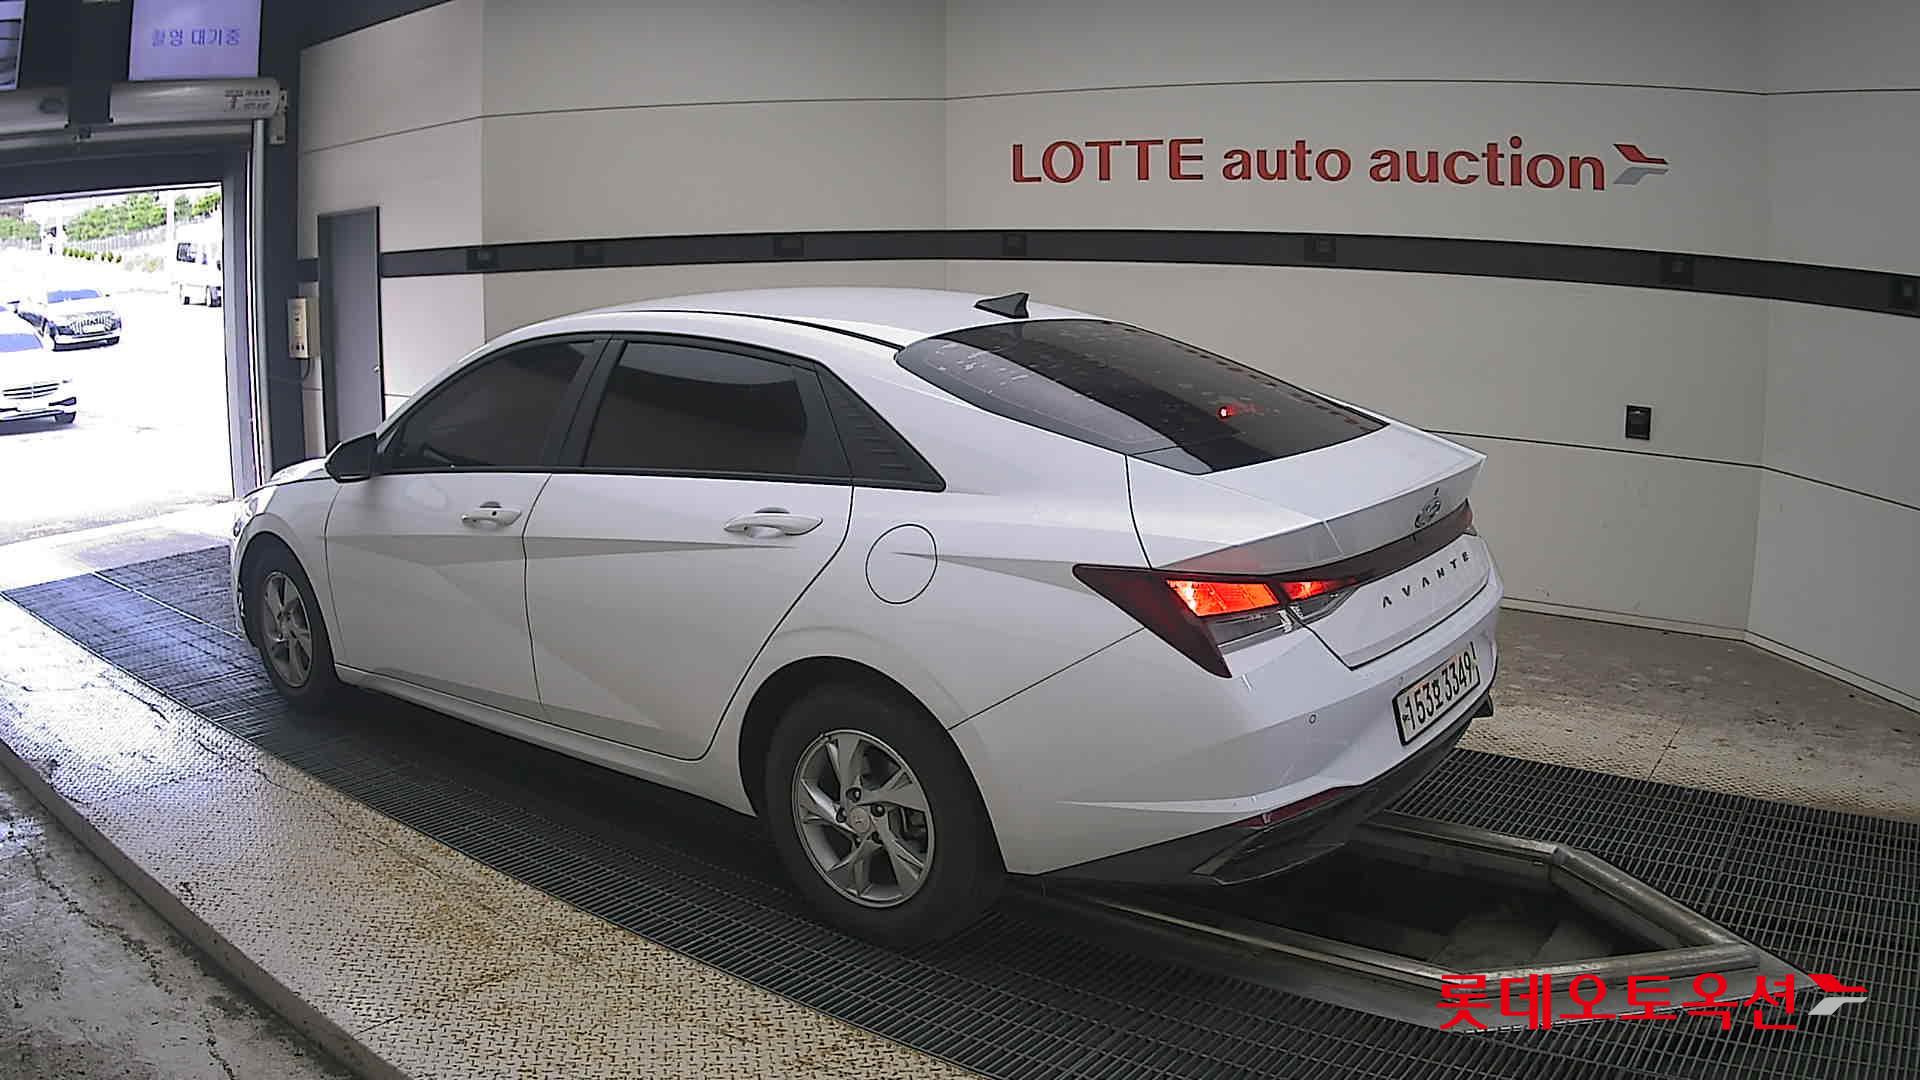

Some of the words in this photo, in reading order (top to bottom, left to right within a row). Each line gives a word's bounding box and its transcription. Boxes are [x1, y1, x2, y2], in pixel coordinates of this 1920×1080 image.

[191, 27, 241, 46] 대기중
[1011, 137, 1205, 184] LOTTE
[1221, 139, 1353, 183] auto
[1368, 135, 1608, 190] auction
[1381, 551, 1471, 609] AVANTE
[1441, 651, 1474, 701] 3349
